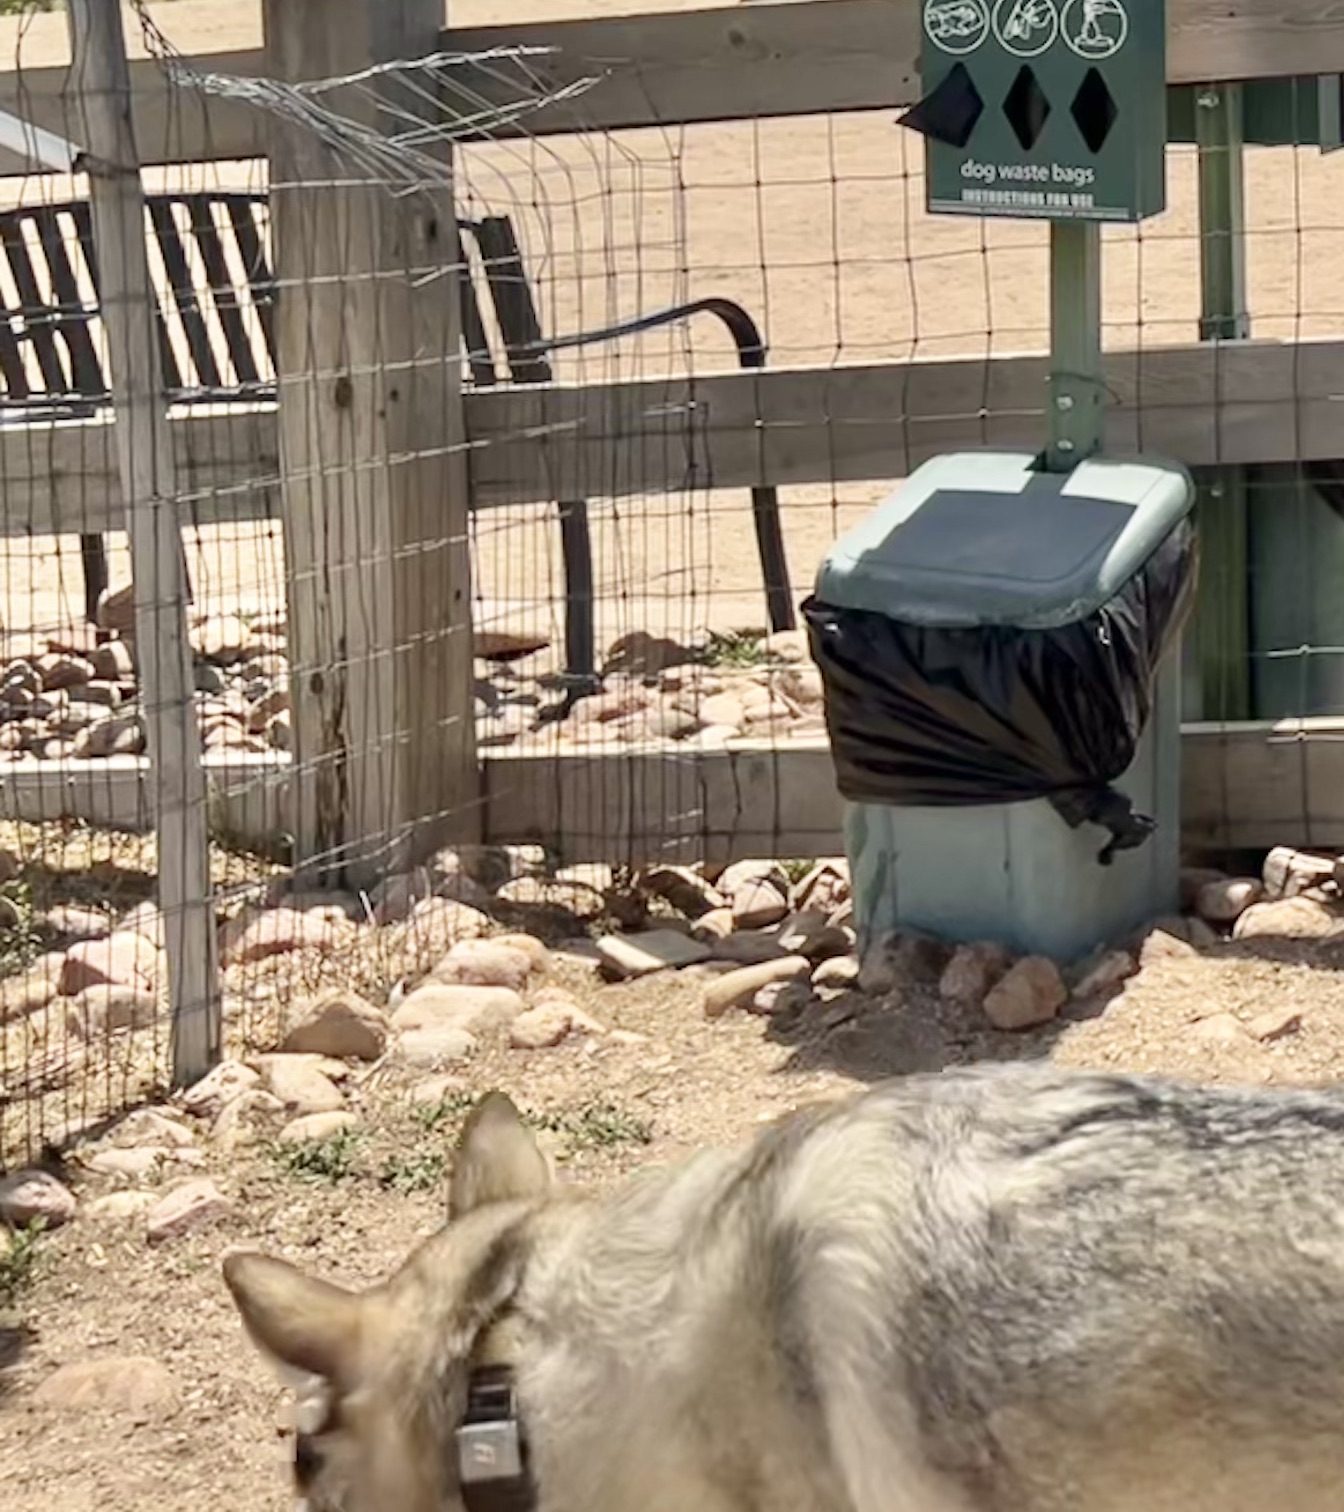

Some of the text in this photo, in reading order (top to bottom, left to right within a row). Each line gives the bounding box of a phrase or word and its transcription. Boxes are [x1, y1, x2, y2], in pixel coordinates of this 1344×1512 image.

[960, 158, 1096, 187] dog waste bags
